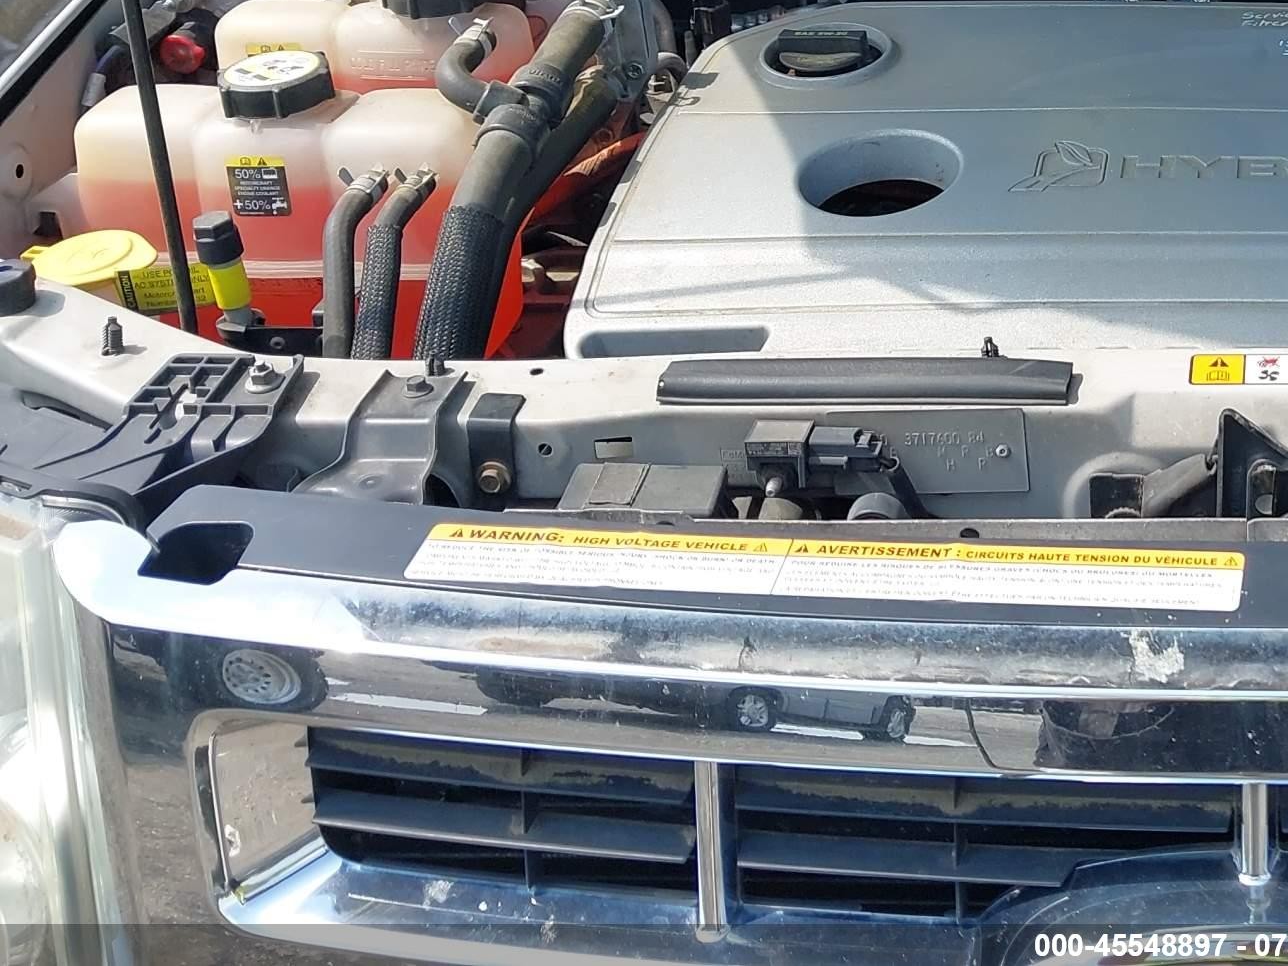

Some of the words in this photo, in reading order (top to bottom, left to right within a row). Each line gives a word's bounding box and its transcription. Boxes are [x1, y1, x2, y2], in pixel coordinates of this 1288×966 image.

[234, 168, 261, 179] 50%
[469, 529, 565, 543] WARNING:
[573, 535, 610, 545] HIGH
[615, 537, 681, 549] VOLTAGE
[685, 541, 748, 551] VEHICLE
[965, 550, 1024, 560] CIRCUITS
[1028, 552, 1070, 562] HAUTE
[1075, 554, 1128, 564] TENSION
[1133, 555, 1150, 565] DU
